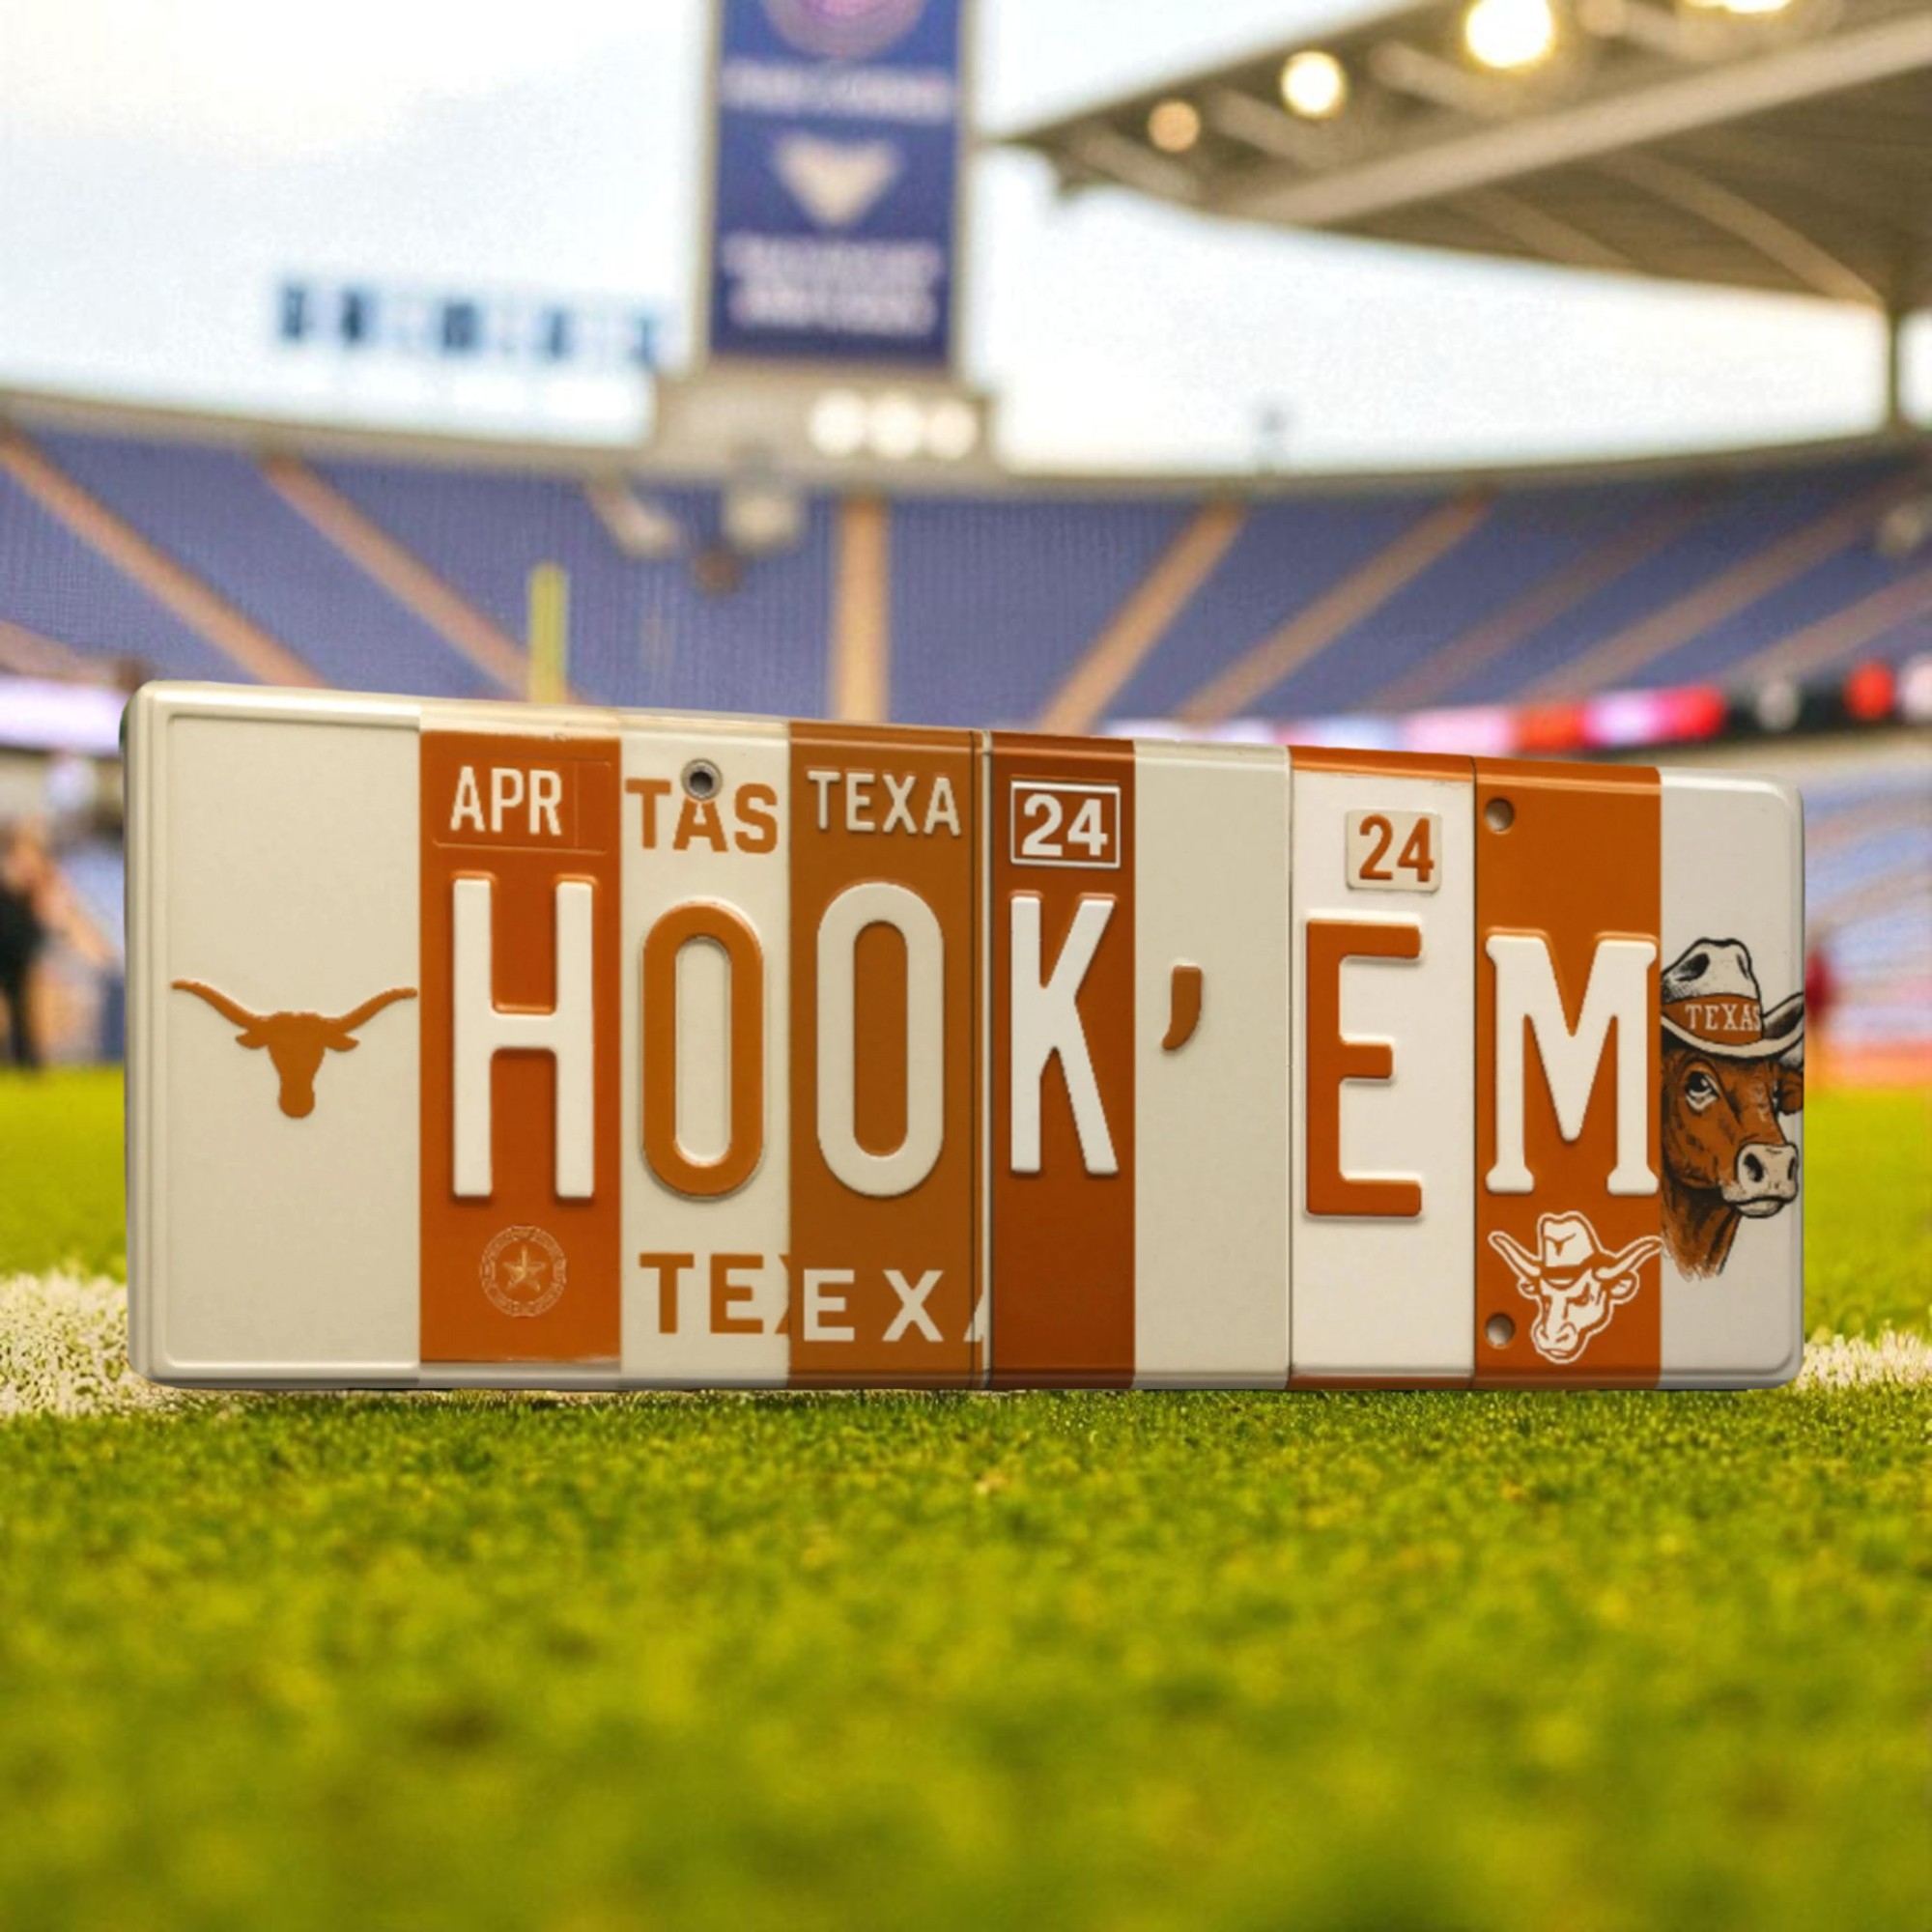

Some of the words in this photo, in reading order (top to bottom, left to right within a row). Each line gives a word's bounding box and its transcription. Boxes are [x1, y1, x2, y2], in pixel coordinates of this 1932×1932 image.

[450, 766, 562, 837] APR
[624, 778, 779, 854] TAS
[808, 770, 961, 838] TEXA
[1022, 792, 1110, 858] 24
[1358, 813, 1435, 883] 24
